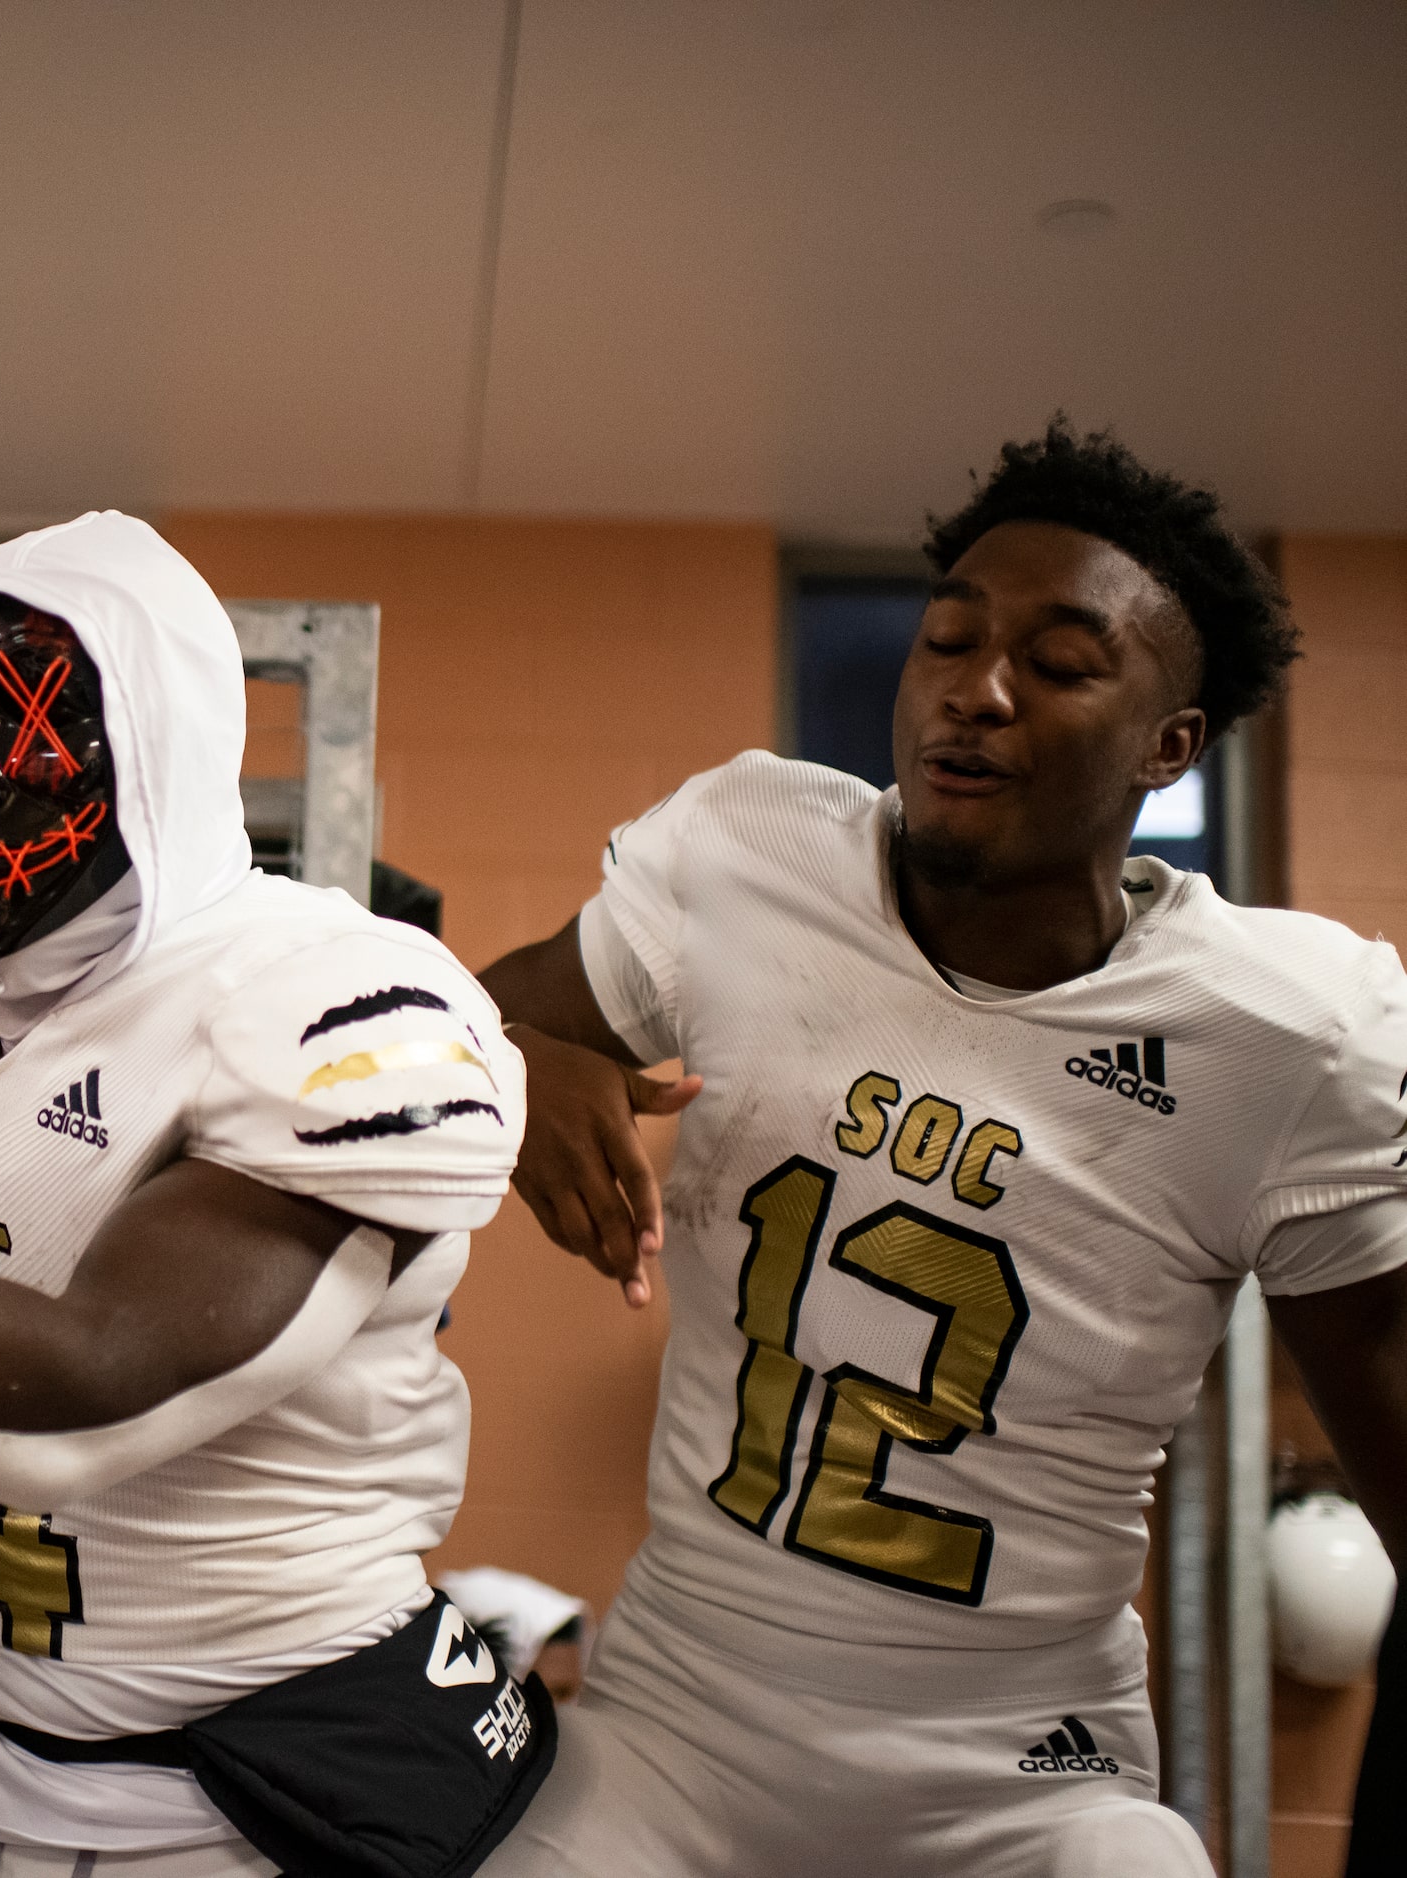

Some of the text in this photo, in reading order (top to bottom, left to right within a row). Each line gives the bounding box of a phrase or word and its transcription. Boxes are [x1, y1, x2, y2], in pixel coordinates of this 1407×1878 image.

[1065, 1057, 1177, 1115] adidas
[37, 1108, 108, 1149] adidas
[834, 1070, 1023, 1211] SOC
[707, 1153, 1031, 1608] 12
[472, 1675, 526, 1760] SHOC
[1018, 1754, 1119, 1775] adidas
